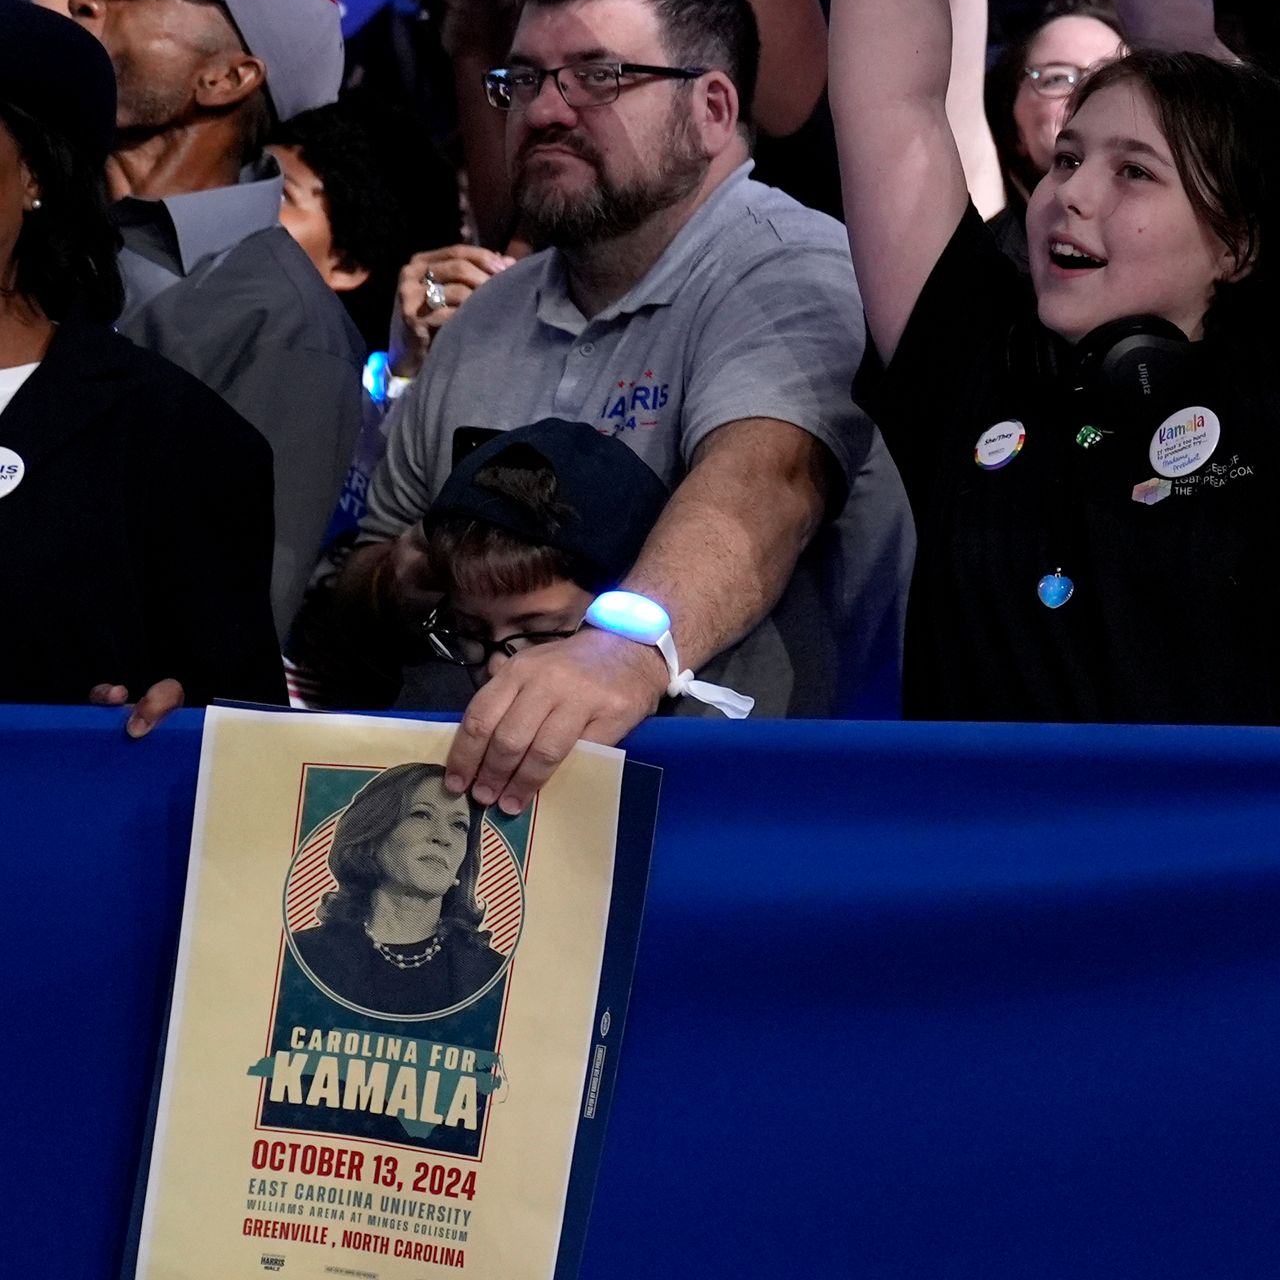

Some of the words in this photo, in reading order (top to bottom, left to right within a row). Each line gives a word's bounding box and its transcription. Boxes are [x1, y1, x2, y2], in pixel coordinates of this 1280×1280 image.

[1159, 414, 1205, 444] Kamala
[291, 1027, 417, 1064] CAROLINA
[429, 1045, 477, 1073] FOR
[269, 1051, 478, 1131] KAMALA
[251, 1139, 365, 1182] OCTOBER
[372, 1154, 403, 1192] 13,
[412, 1161, 477, 1201] 2024
[246, 1199, 304, 1216] WILLIAMS
[309, 1206, 345, 1221] ARENA
[350, 1211, 362, 1223] AT
[367, 1214, 409, 1232] MINGES
[413, 1222, 468, 1242] COLISEUM
[248, 1178, 289, 1198] EAST
[295, 1183, 373, 1210] CAROLINA
[380, 1195, 472, 1227] UNIVERSITY
[260, 1256, 285, 1267] HARRIS
[341, 1230, 390, 1255] NORTH
[393, 1238, 465, 1269] CAROLINA
